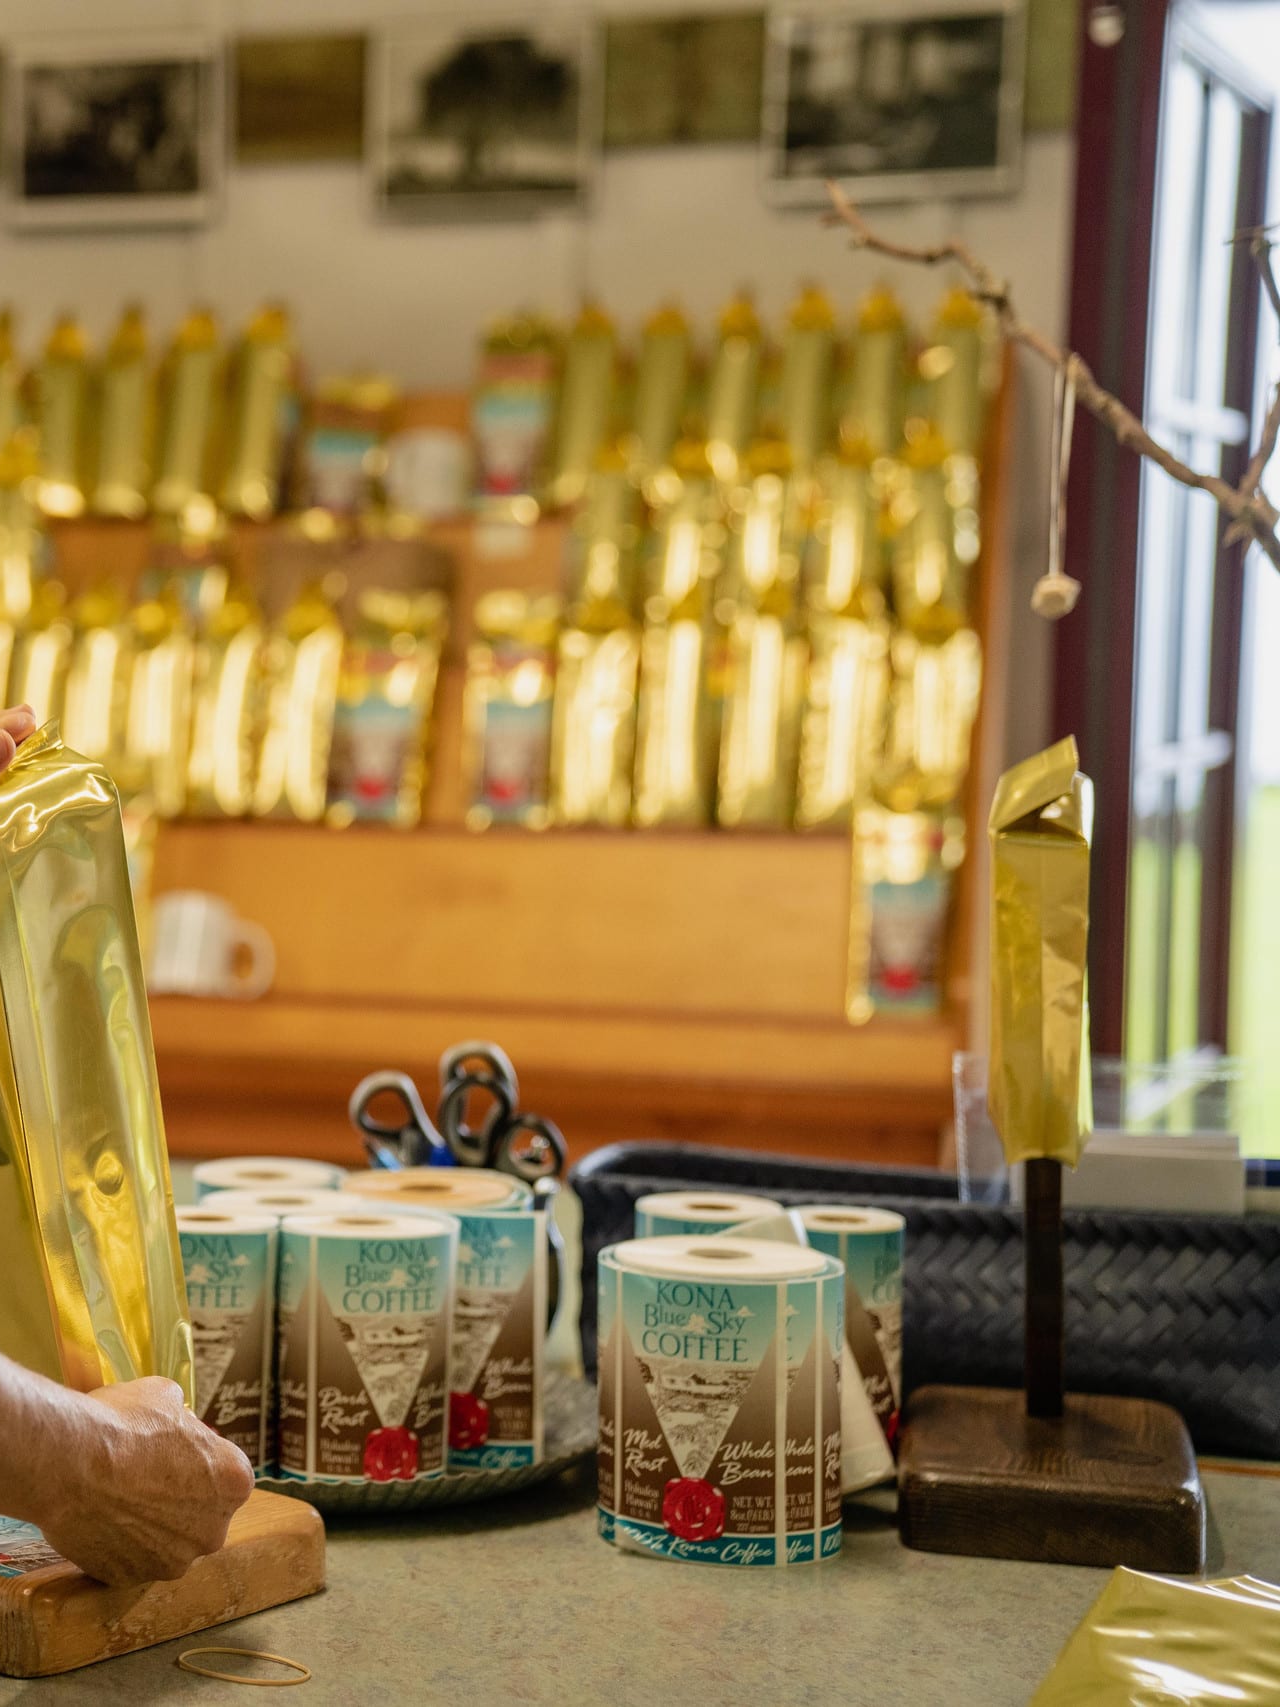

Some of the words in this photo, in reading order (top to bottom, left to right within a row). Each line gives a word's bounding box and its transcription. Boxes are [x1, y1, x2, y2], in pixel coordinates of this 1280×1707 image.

[181, 1237, 237, 1259] ONA
[359, 1240, 431, 1264] KONA
[344, 1263, 391, 1289] Blue
[342, 1287, 436, 1313] COFFEE
[656, 1281, 736, 1310] KONA
[643, 1303, 687, 1328] Blue
[705, 1310, 748, 1336] Sky
[641, 1329, 749, 1363] COFFEE
[318, 1386, 370, 1409] Dark
[320, 1406, 370, 1435] Roast
[623, 1427, 663, 1450] Med
[719, 1440, 775, 1461] Whole
[624, 1447, 668, 1478] Roast
[717, 1461, 775, 1486] Bean
[785, 1464, 815, 1477] ean
[665, 1535, 719, 1558] Kona
[719, 1541, 773, 1565] Coffee
[785, 1539, 812, 1562] ffee
